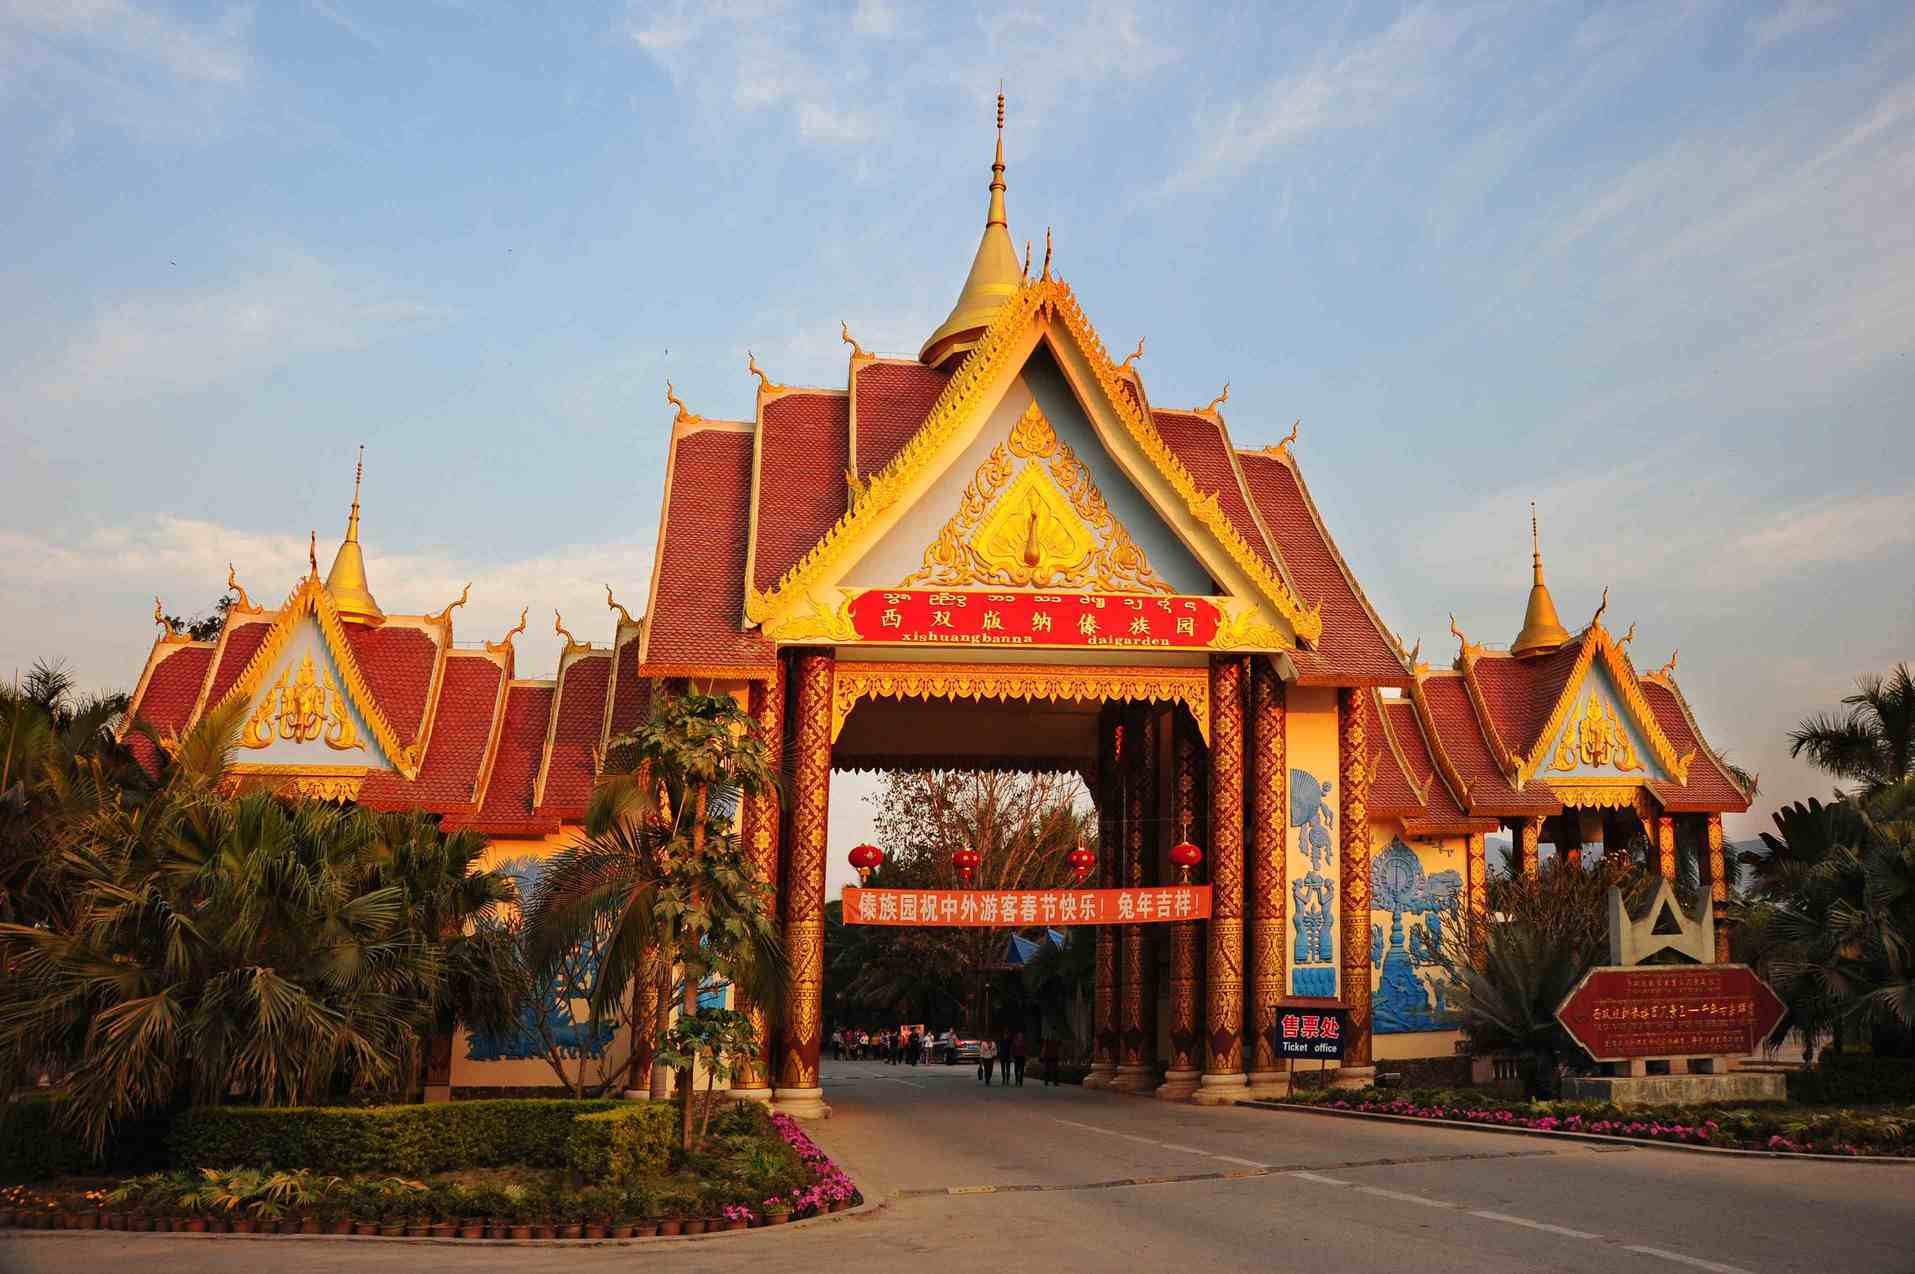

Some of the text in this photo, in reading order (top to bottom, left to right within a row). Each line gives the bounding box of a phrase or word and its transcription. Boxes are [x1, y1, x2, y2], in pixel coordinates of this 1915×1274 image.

[880, 608, 1195, 637] 西双版纳傣族园
[901, 631, 1033, 644] xishuangbanna
[1281, 1014, 1340, 1039] 售票处
[1283, 1041, 1337, 1053] Ticket office
